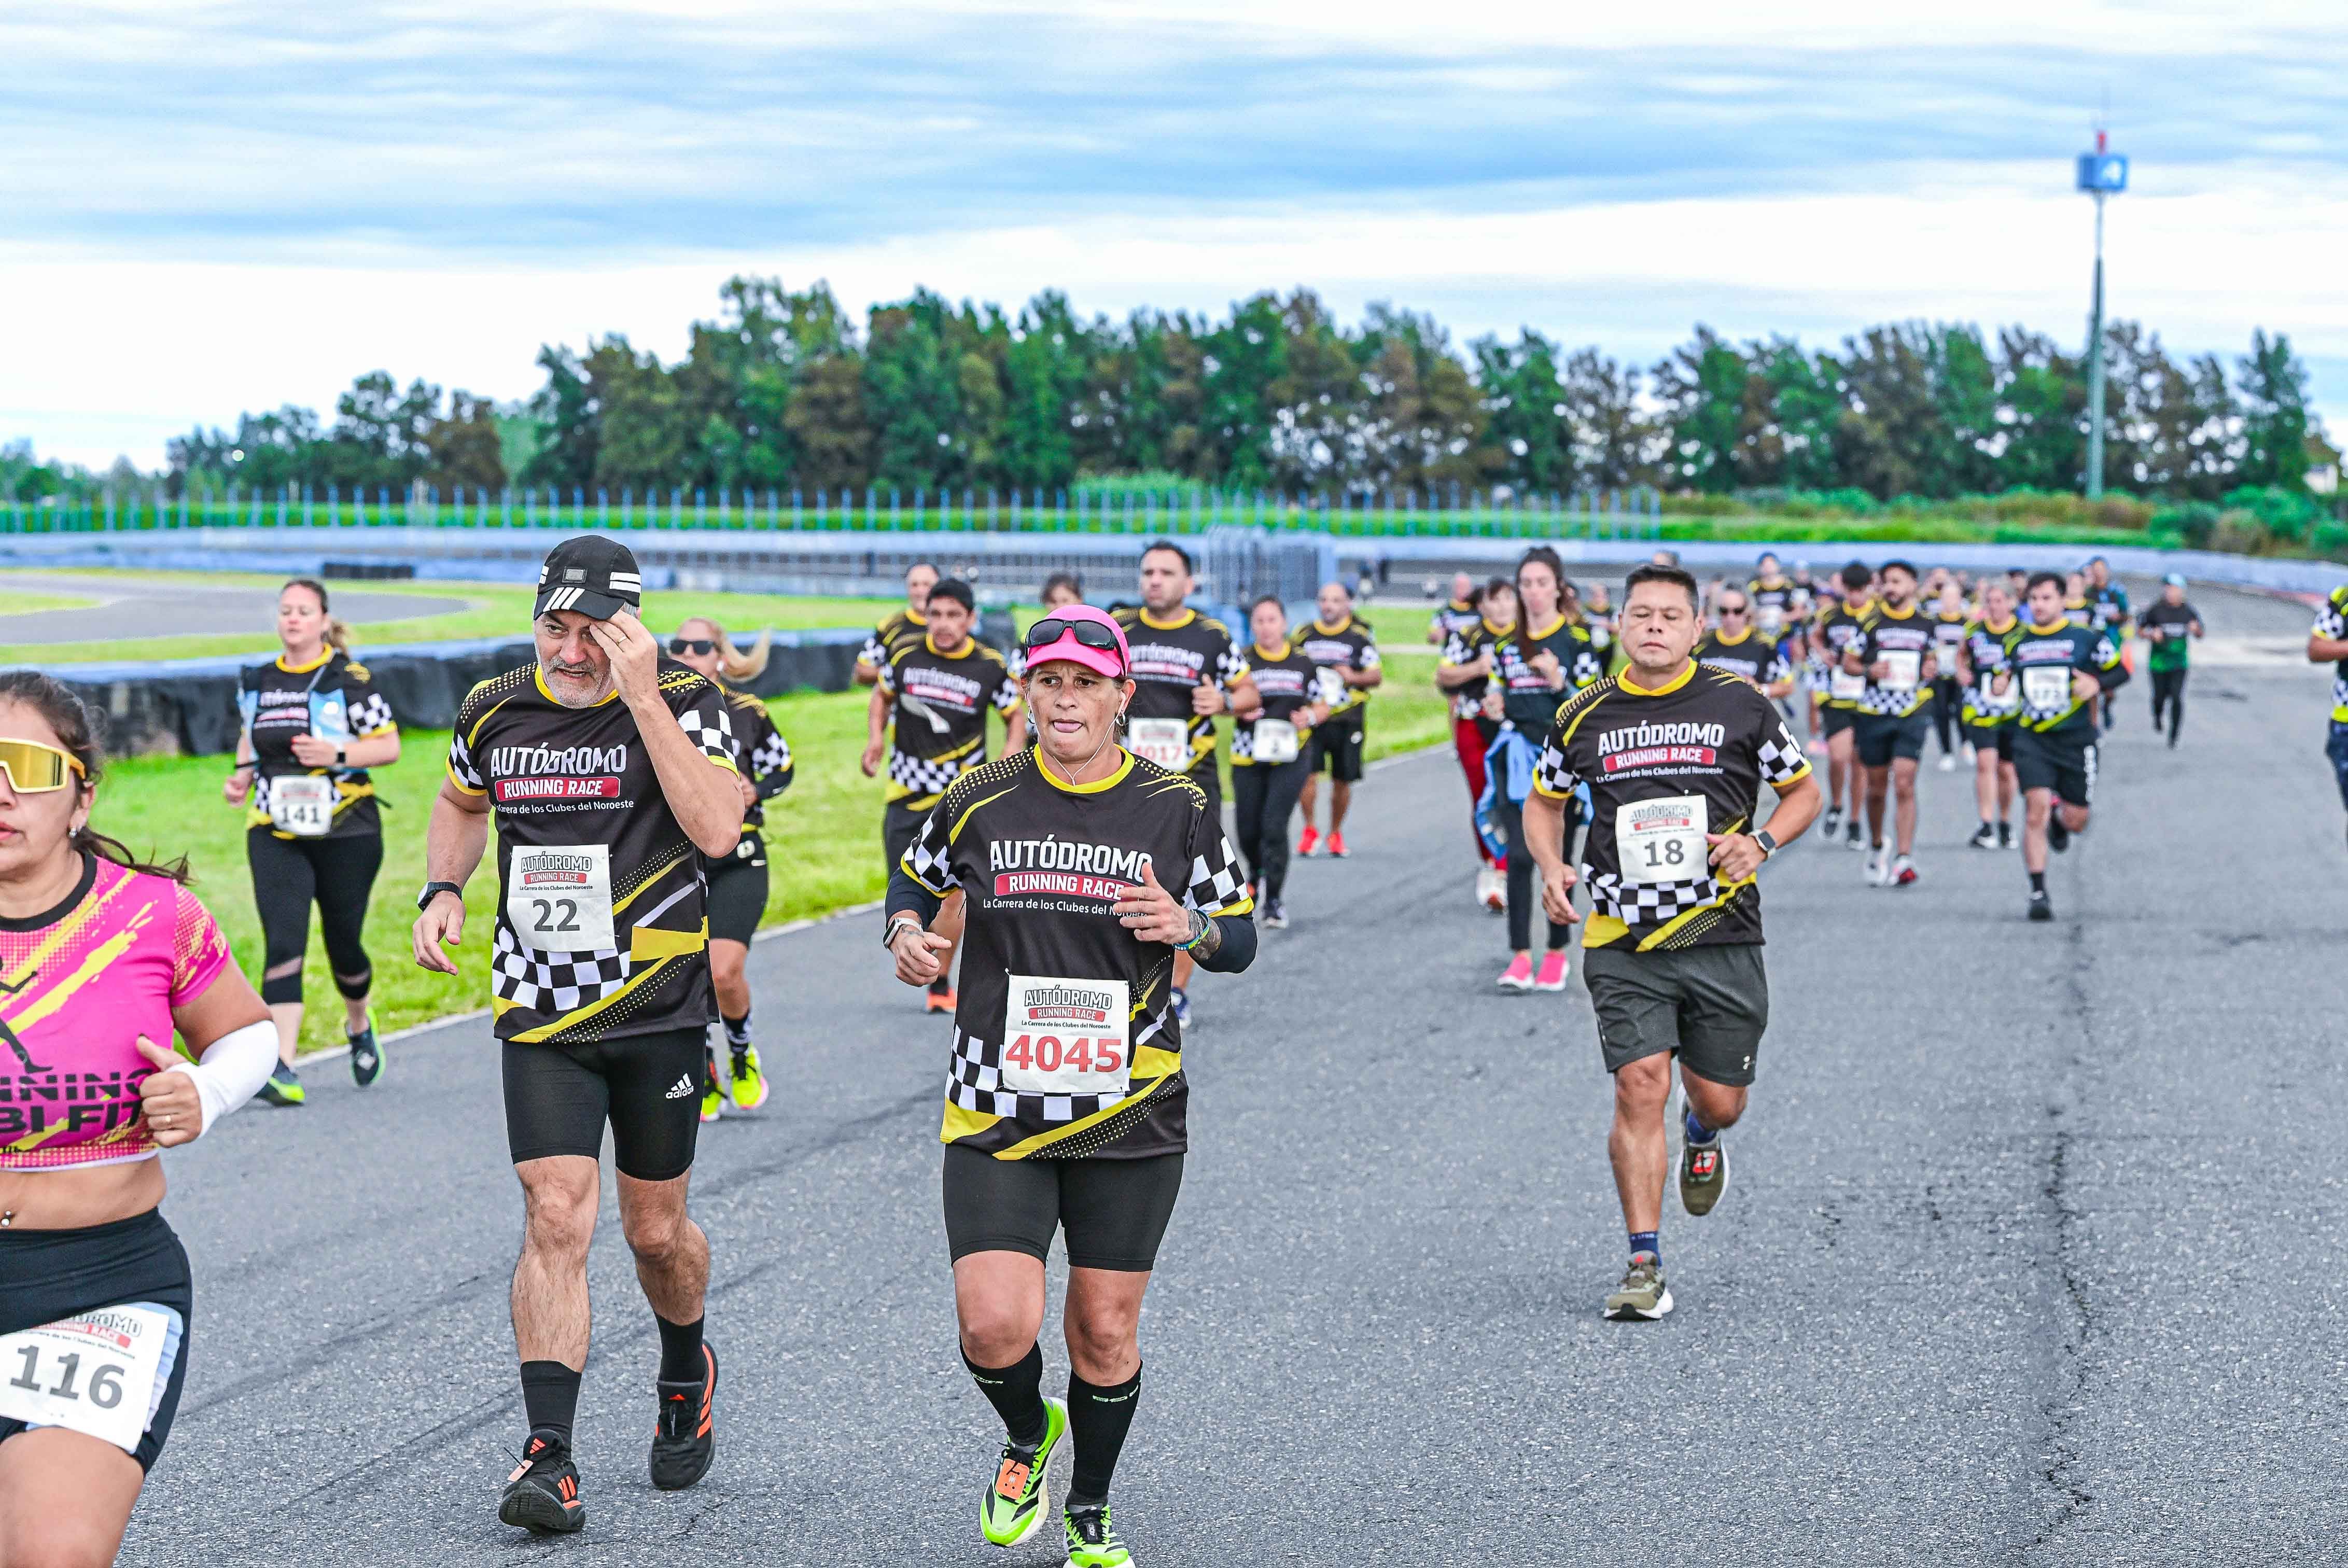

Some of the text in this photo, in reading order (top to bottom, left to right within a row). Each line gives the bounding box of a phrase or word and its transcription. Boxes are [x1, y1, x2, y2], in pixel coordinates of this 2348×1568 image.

[1598, 719, 1725, 757] AUTÓDROMO
[491, 741, 626, 777] AUTÓDROMO
[1615, 748, 1703, 769] RUNNING RACE
[1631, 769, 1641, 778] de
[1653, 766, 1678, 776] Clubes
[1679, 766, 1691, 775] del
[504, 779, 604, 799] RUNNING RACE
[281, 806, 320, 823] 141
[519, 804, 530, 814] de
[531, 804, 544, 813] los
[546, 803, 577, 813] Clubes
[578, 801, 592, 811] del
[594, 800, 634, 810] Noroeste
[521, 851, 592, 873] AUTÓDROMO
[990, 834, 1153, 883] AUTÓDROMO
[1644, 839, 1684, 866] 18
[530, 873, 557, 883] RUNNING
[1009, 874, 1125, 901] RUNNING RACE
[533, 899, 580, 931] 22
[983, 898, 991, 908] La
[993, 898, 1024, 909] Carrera
[1026, 899, 1038, 908] de
[1040, 899, 1054, 910] los
[1057, 901, 1089, 914] Clubes
[1092, 903, 1107, 915] del
[1025, 985, 1112, 1010] AUTÓDROMO
[1037, 1008, 1095, 1020] RUNNING RACE
[1006, 1034, 1121, 1072] 4045
[665, 1085, 694, 1099] adidas
[10, 1345, 125, 1409] 116
